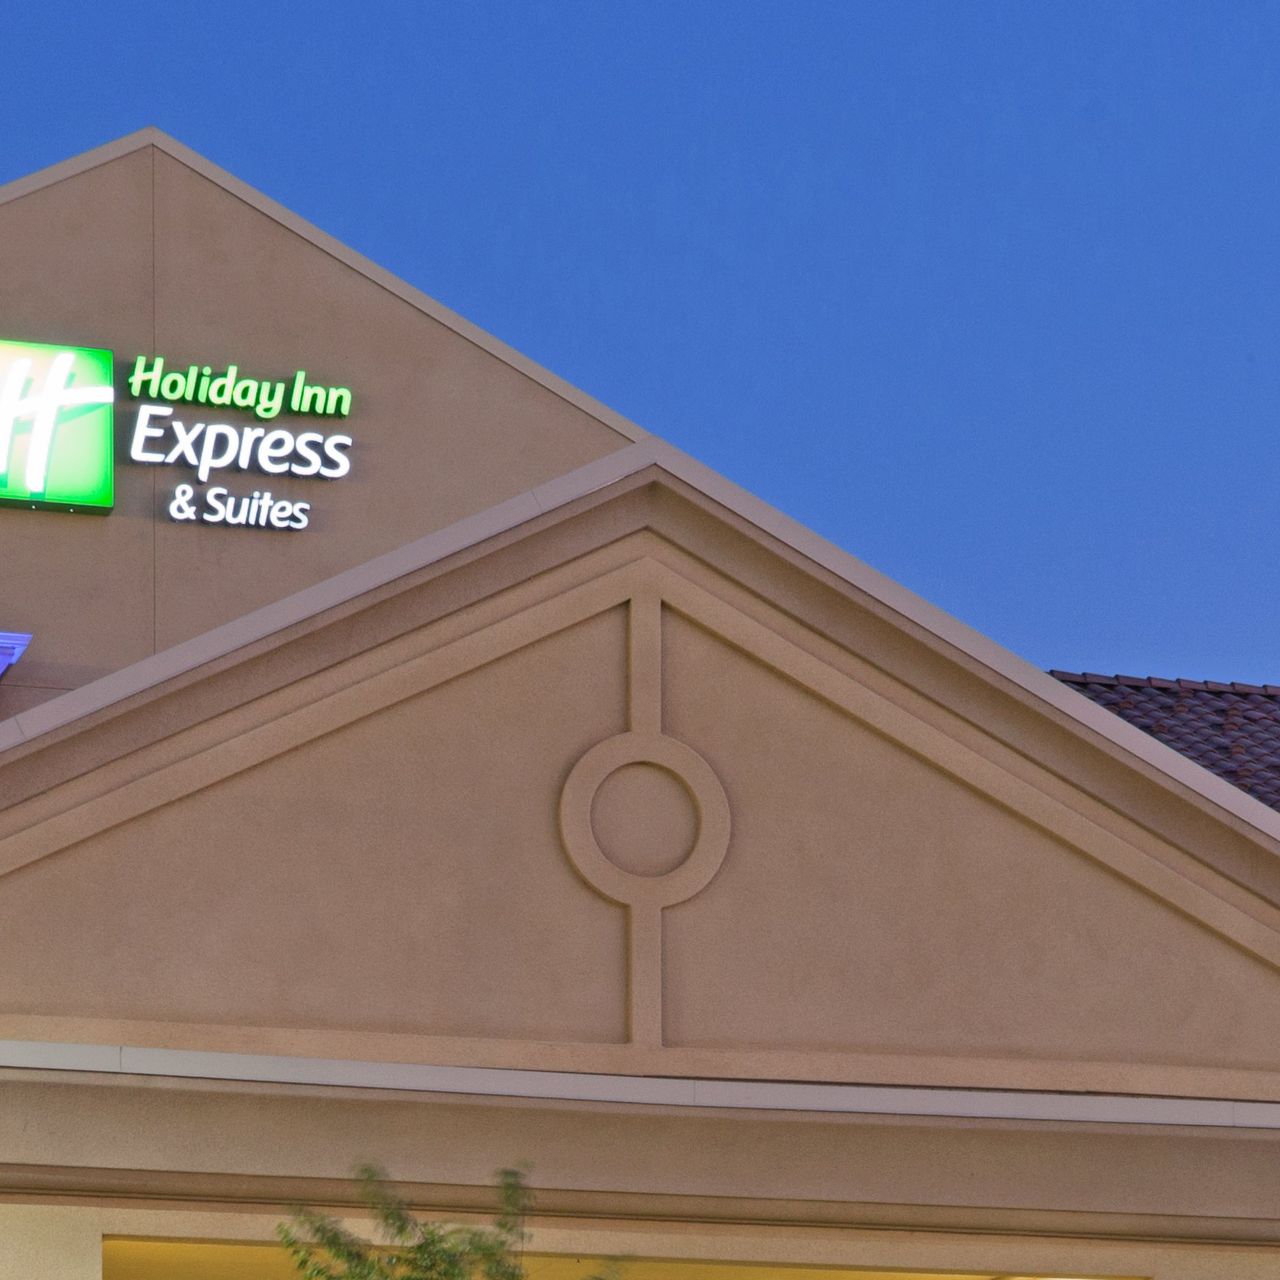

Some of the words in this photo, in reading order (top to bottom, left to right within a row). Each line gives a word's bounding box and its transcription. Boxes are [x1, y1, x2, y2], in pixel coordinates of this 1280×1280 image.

[128, 356, 284, 420] Holiday
[292, 371, 352, 416] Inn
[130, 404, 353, 483] Express
[169, 484, 197, 521] &
[202, 487, 311, 530] Suites
